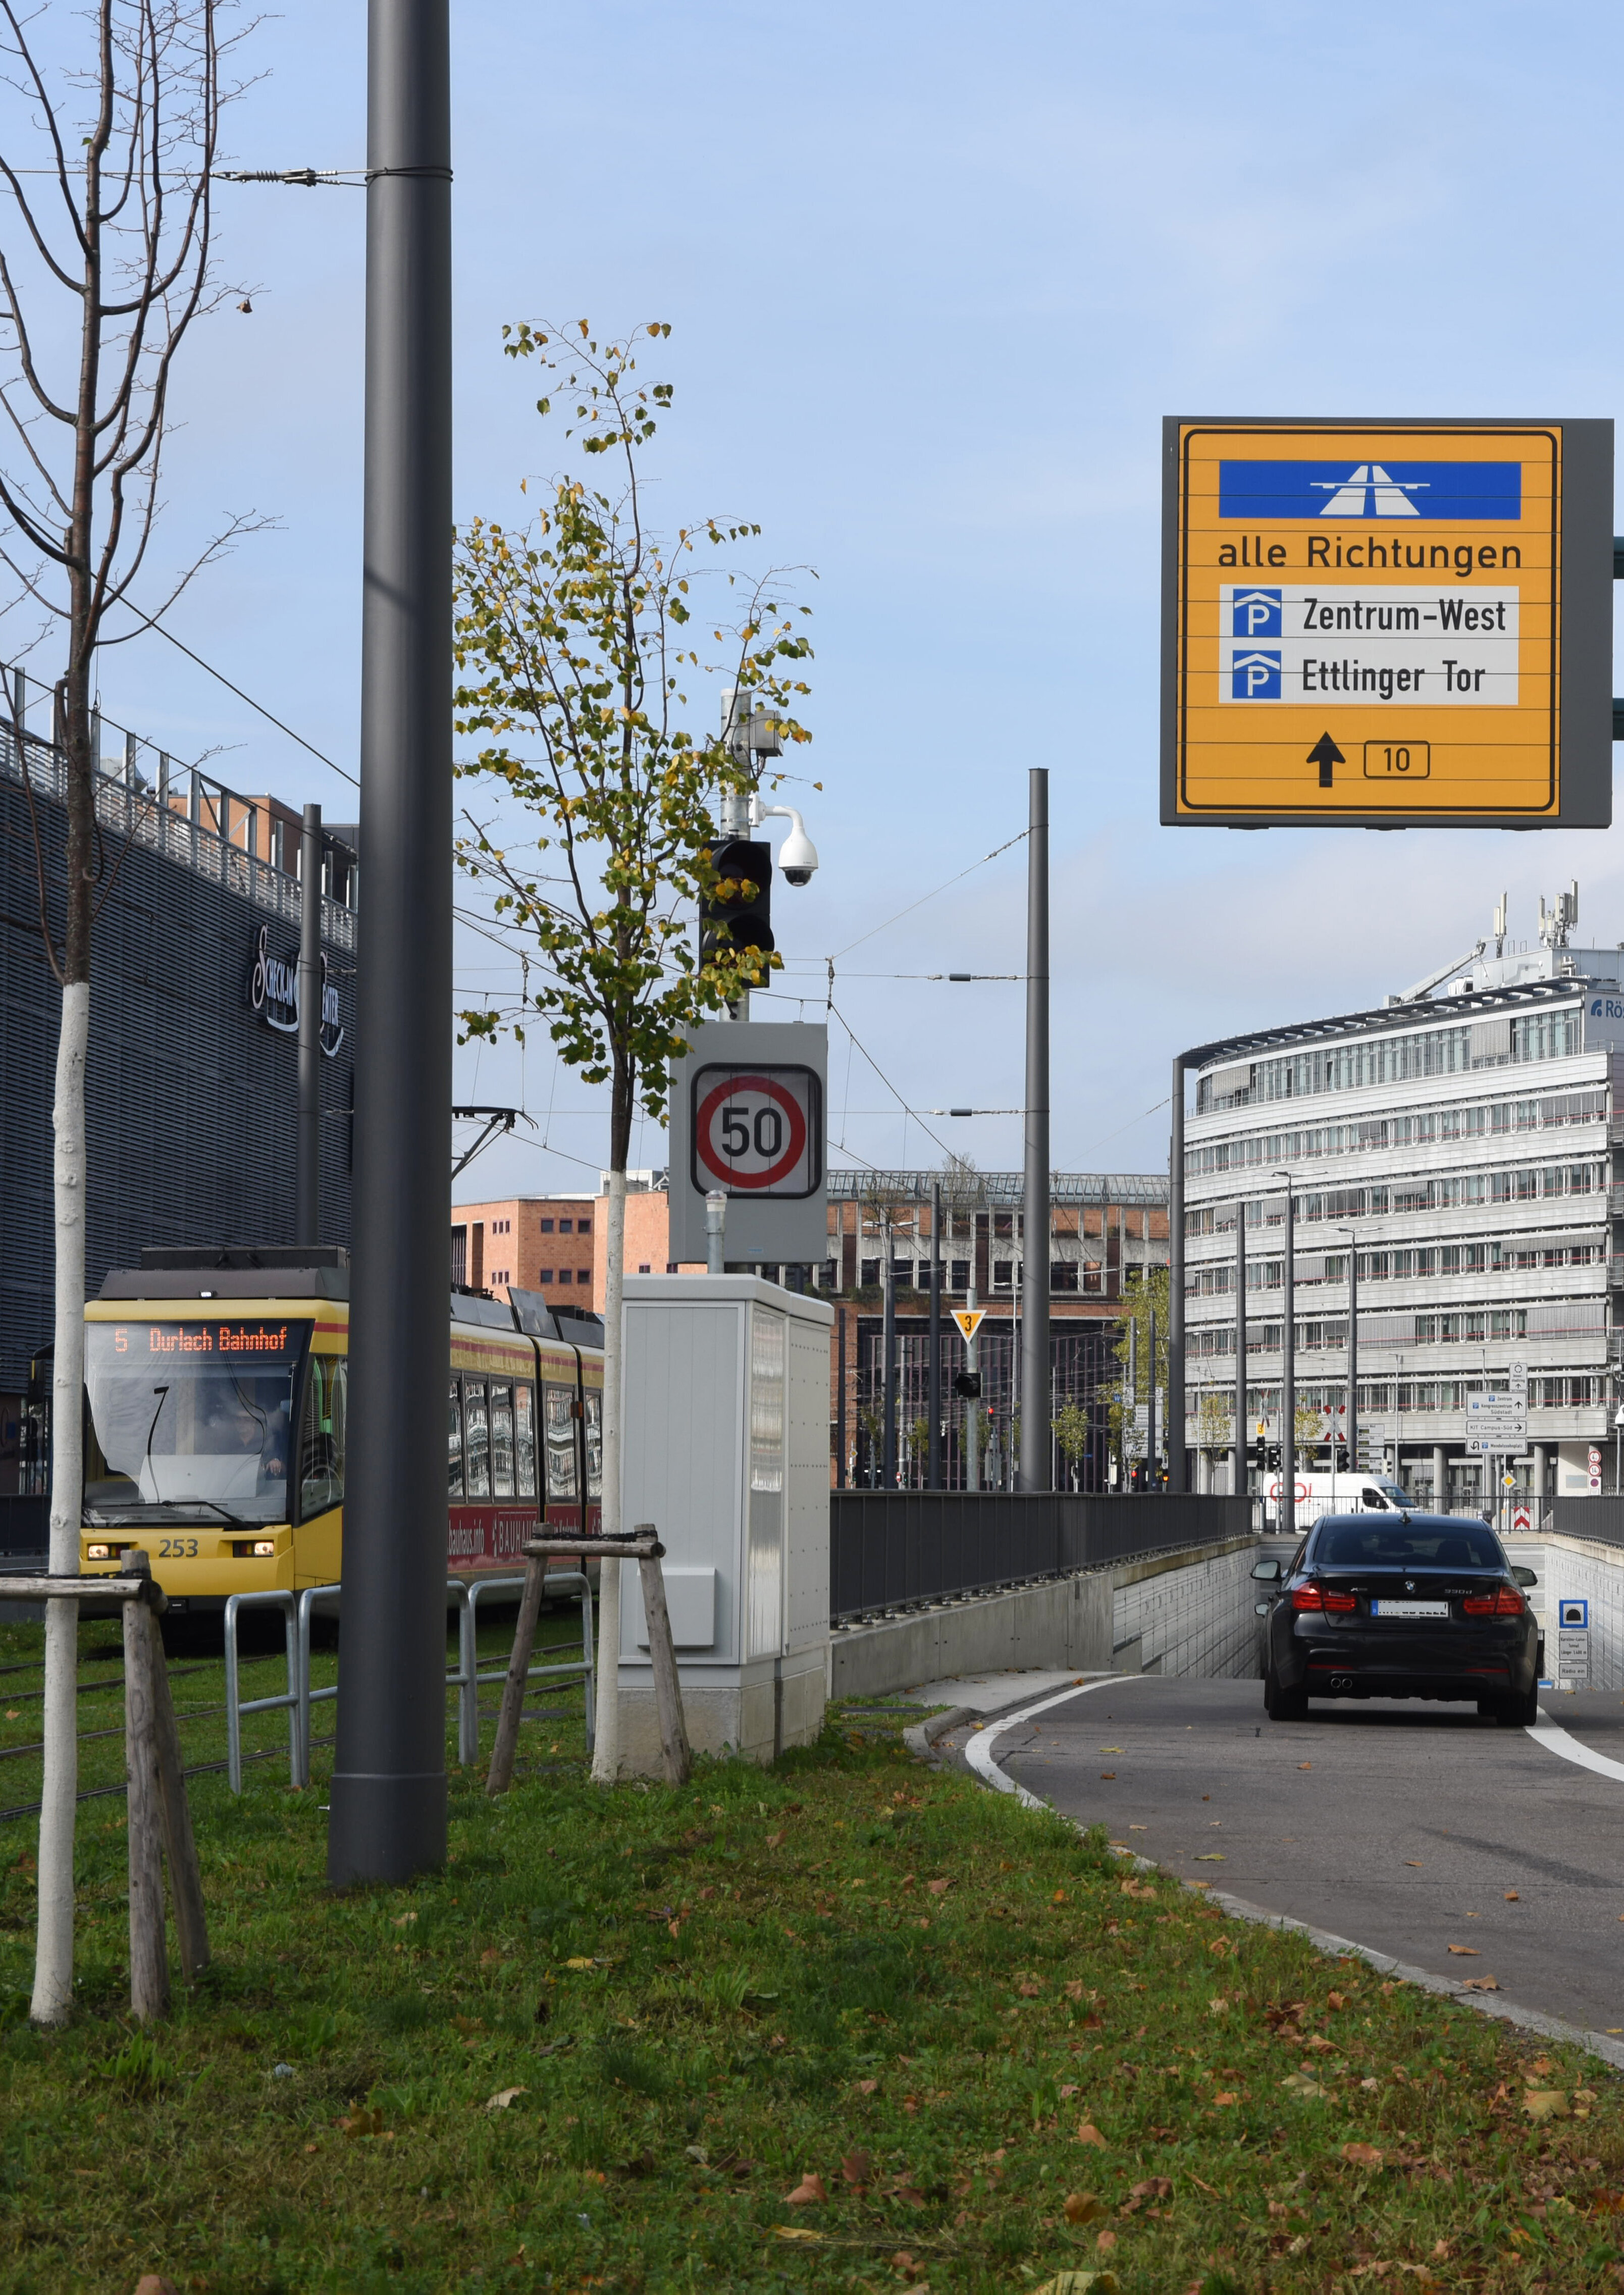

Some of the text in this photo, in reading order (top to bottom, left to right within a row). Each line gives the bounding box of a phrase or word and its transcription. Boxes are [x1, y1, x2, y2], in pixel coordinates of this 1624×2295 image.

[1219, 536, 1521, 577] alle Richtungen
[1303, 598, 1506, 631] Zentrum-West
[1302, 659, 1425, 700] Ettlinger
[1442, 660, 1486, 692] Tor
[1383, 747, 1410, 771] 10
[1605, 1000, 1624, 1018] Rö
[721, 1107, 782, 1157] 50
[964, 1315, 972, 1331] 3
[115, 1326, 287, 1352] 5 Durlach Bahnhof
[159, 1539, 198, 1558] 253
